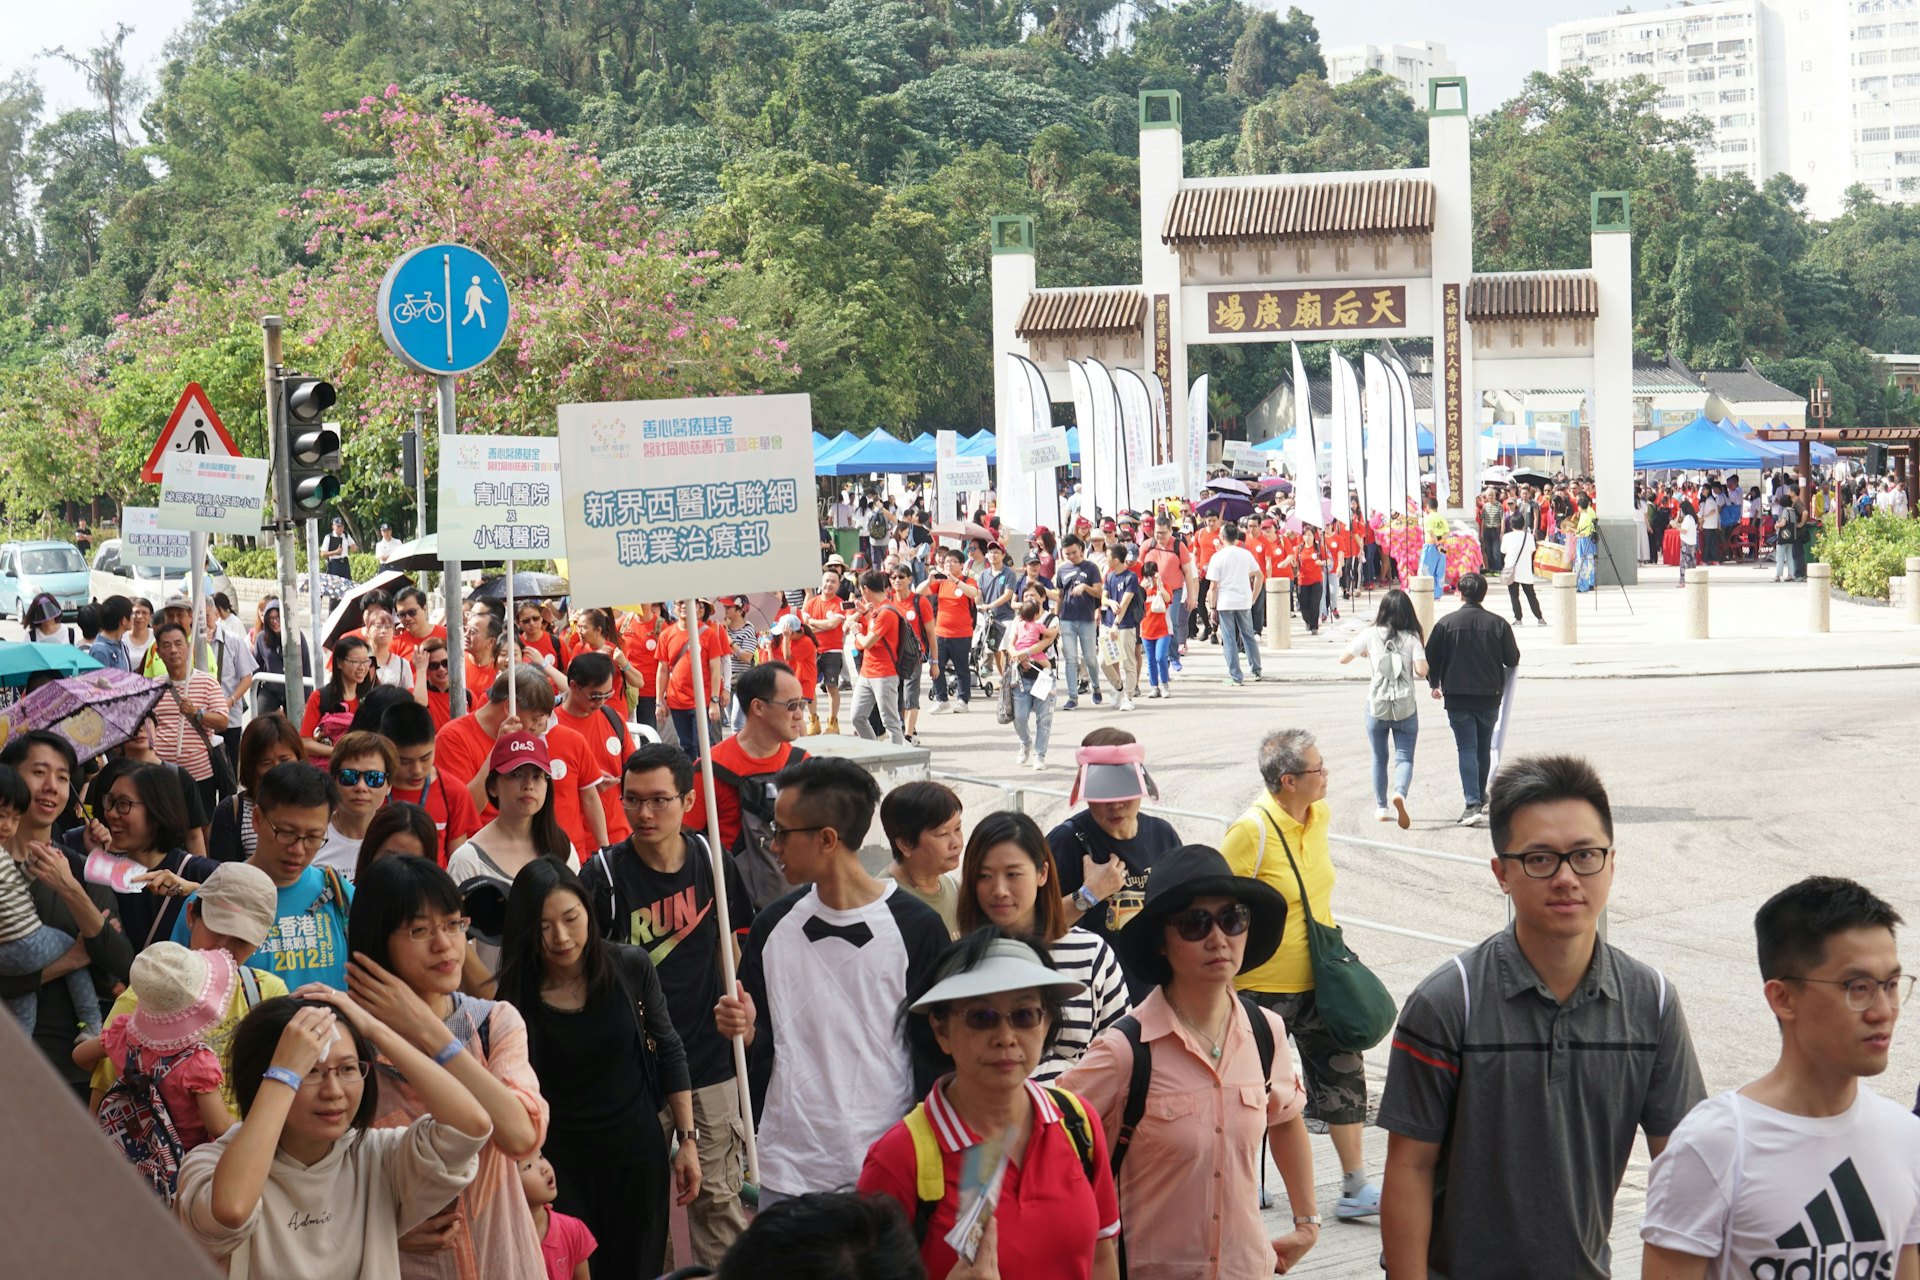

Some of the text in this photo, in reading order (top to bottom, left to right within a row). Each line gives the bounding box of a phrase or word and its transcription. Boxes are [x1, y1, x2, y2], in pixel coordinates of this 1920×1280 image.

[474, 482, 550, 506] 青山醫院
[584, 478, 798, 528] 新界西醫院聯網
[506, 510, 517, 522] 及
[473, 525, 550, 549] 小欖醫院
[616, 520, 771, 566] 職業治療部
[510, 740, 535, 752] Q&S
[278, 914, 317, 938] 香港
[630, 885, 698, 946] RUN
[253, 935, 318, 955] 公里挑戰賽
[274, 948, 321, 972] 2012
[1750, 1241, 1894, 1280] adidas
